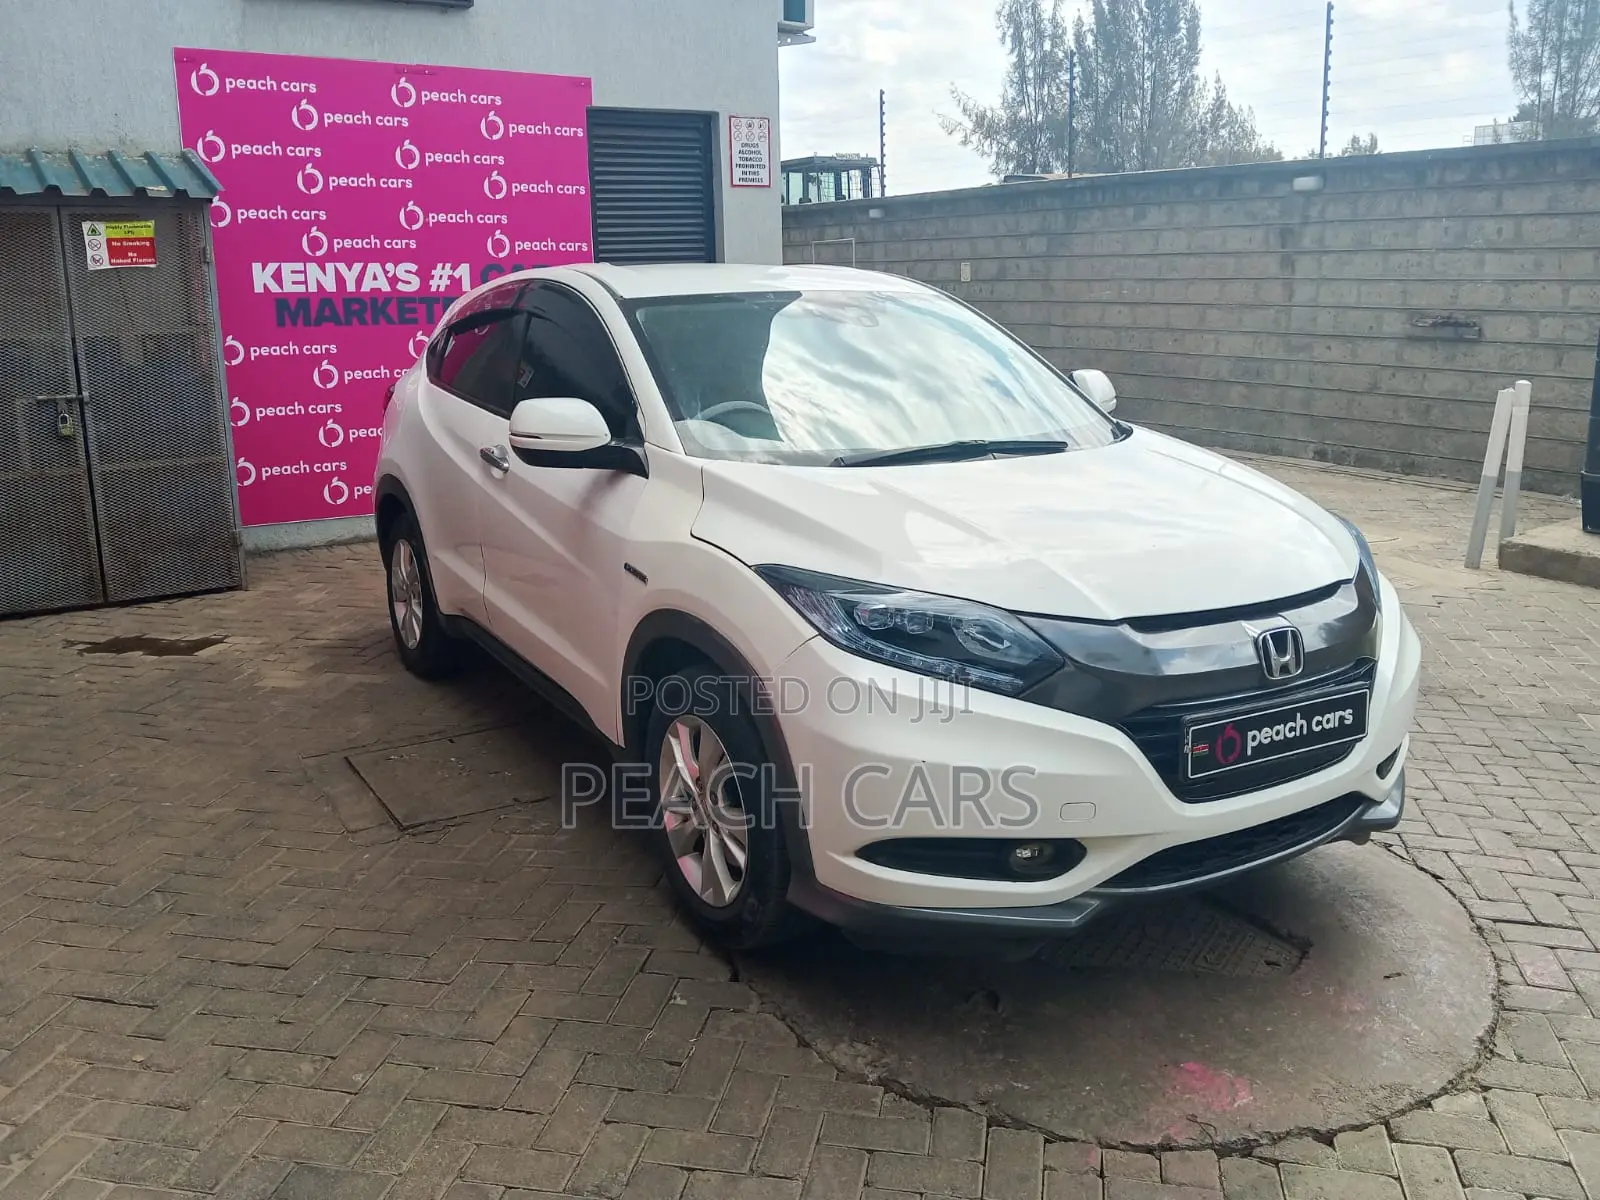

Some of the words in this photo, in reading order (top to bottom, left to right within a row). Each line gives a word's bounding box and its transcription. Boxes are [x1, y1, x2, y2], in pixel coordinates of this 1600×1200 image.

[225, 75, 278, 93] peach
[281, 81, 318, 94] cars
[421, 88, 467, 106] peach
[470, 94, 503, 106] cars
[323, 110, 371, 128] peach
[374, 115, 410, 128] cars
[508, 121, 552, 138] peach
[555, 126, 585, 138] cars
[231, 140, 283, 160] peach
[286, 146, 323, 158] cars
[424, 149, 471, 167] peach
[474, 154, 506, 166] cars
[328, 172, 377, 191] peach
[380, 178, 414, 189] cars
[511, 180, 554, 197] peach
[557, 184, 587, 195] cars
[237, 204, 288, 224] peach
[291, 209, 328, 221] cars
[426, 209, 474, 227] peach
[477, 214, 509, 225] cars
[333, 234, 381, 253] peach
[384, 239, 418, 249] cars
[514, 237, 557, 255] peach
[560, 242, 590, 252] cars
[251, 262, 421, 293] KENYA'S
[428, 262, 472, 292] #1
[274, 297, 456, 326] MARKET
[250, 341, 300, 361] peach
[303, 344, 338, 355] cars
[343, 365, 390, 385] peach
[255, 401, 305, 421] peach
[308, 403, 343, 414] cars
[261, 460, 310, 479] peach
[313, 461, 348, 473] cars
[1246, 712, 1308, 757] peach
[1311, 708, 1354, 732] cars
